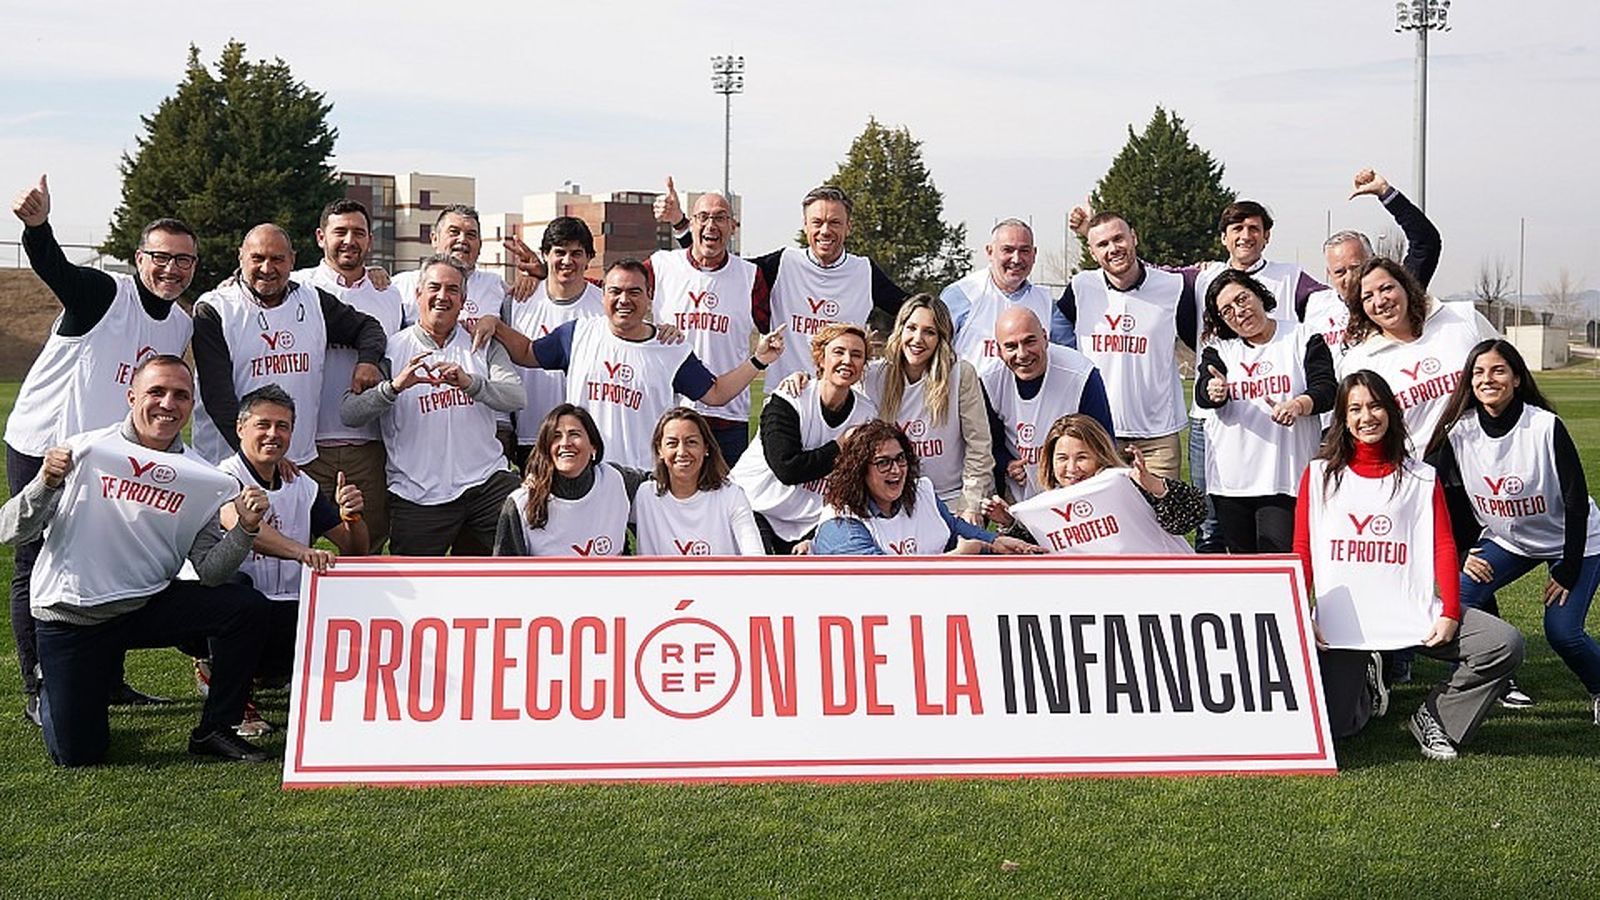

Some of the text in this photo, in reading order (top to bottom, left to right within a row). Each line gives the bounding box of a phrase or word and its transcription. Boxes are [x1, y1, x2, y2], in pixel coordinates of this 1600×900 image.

[675, 312, 729, 334] TE PROTEJO
[792, 315, 808, 333] TE
[984, 340, 996, 357] TE
[1091, 335, 1148, 354] TE PROTEJO
[115, 363, 131, 384] TE
[251, 353, 309, 377] TE PROTEJO
[588, 382, 643, 411] TE PROTEJO
[1241, 374, 1291, 400] PROTEJO
[419, 395, 432, 413] TE
[101, 476, 185, 513] TE PROTEJO
[1474, 494, 1546, 518] TE PROTEJO
[1047, 515, 1119, 551] TE PROTEJO
[1348, 512, 1392, 536] YO
[1331, 539, 1407, 565] TE PROTEJO
[320, 600, 1299, 722] PROTECCIÓN DE LA INFANCIA
